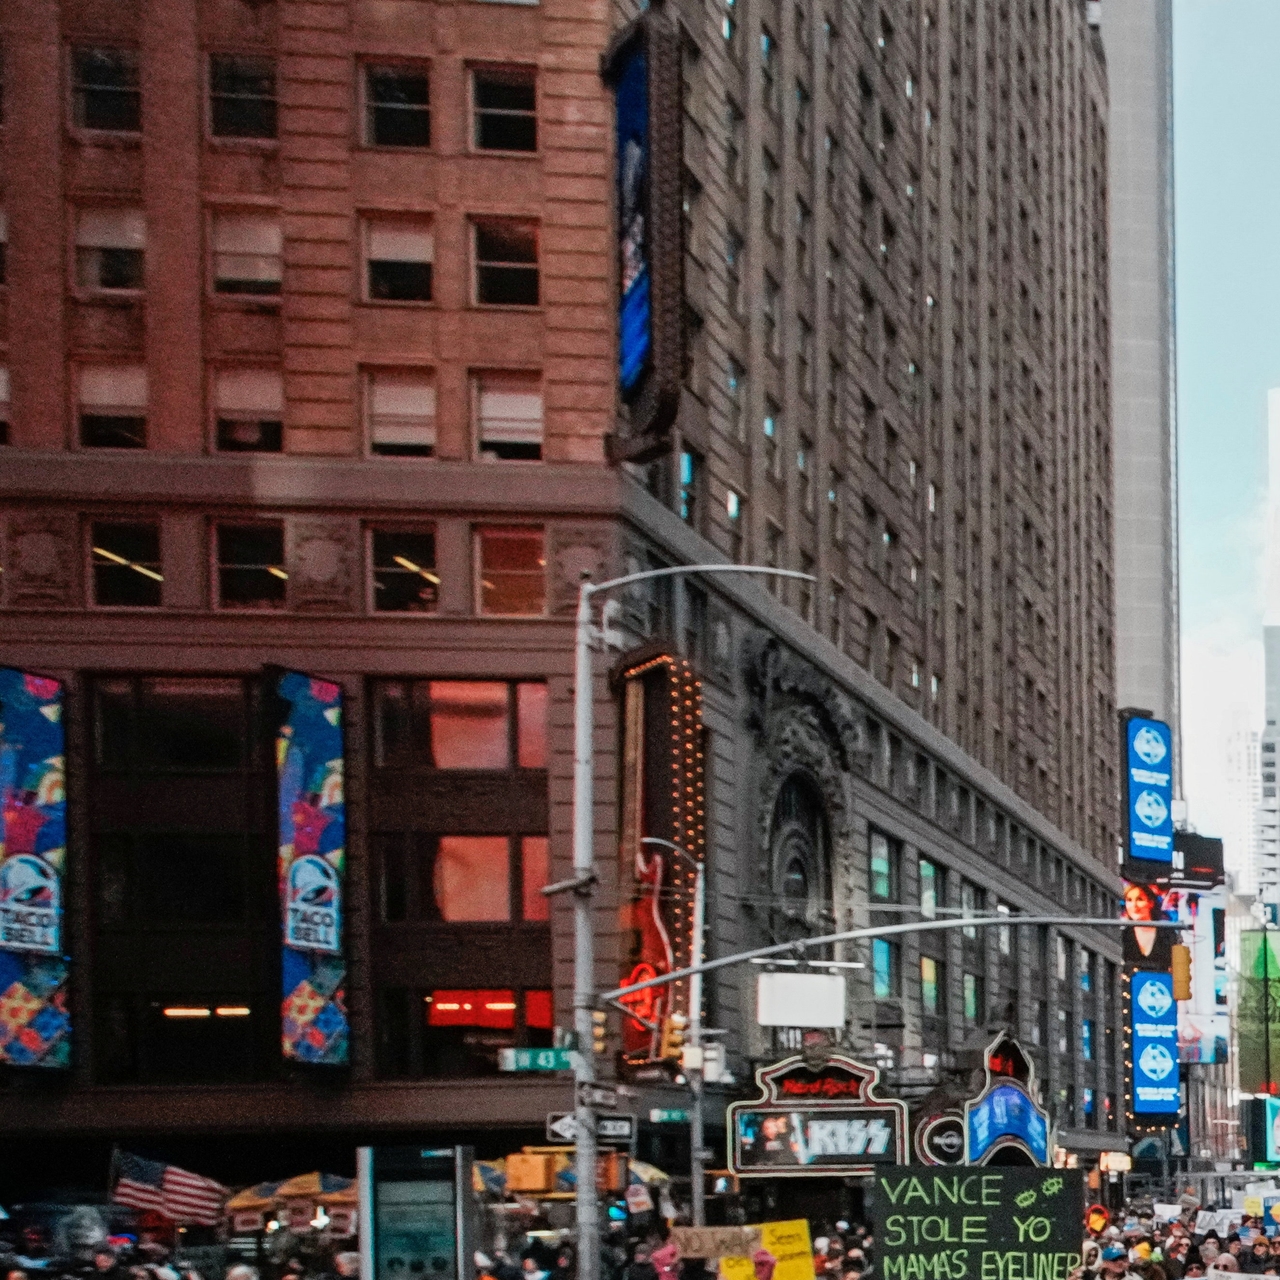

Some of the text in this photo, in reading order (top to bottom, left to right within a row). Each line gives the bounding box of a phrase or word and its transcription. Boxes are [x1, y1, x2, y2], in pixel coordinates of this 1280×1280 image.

[290, 908, 334, 927] TACO
[293, 926, 333, 945] BELL
[807, 1119, 891, 1154] KISS
[881, 1175, 1003, 1206] VANCE
[884, 1215, 1051, 1246] STOLE YO
